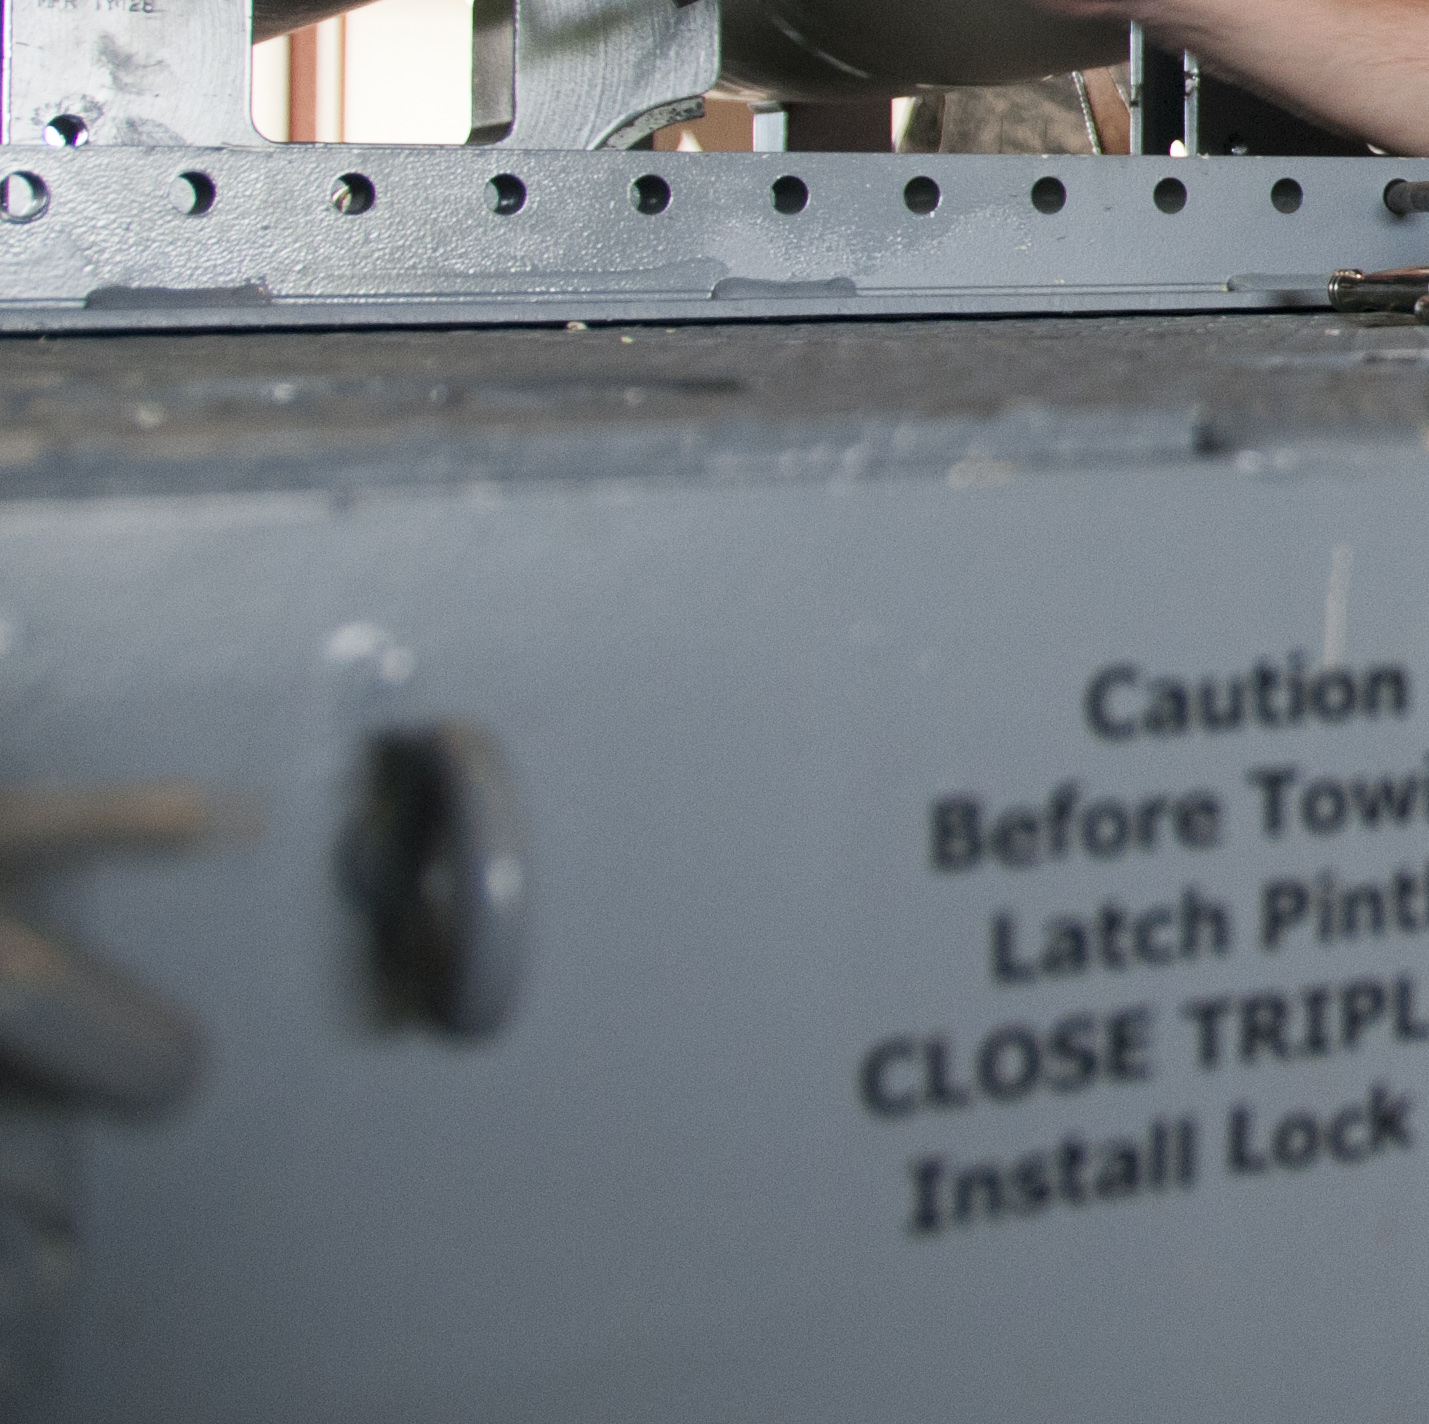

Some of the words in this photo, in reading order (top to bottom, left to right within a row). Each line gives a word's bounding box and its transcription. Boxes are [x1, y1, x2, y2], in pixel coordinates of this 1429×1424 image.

[1082, 650, 1413, 743] Caution
[929, 781, 1222, 874] Before
[991, 889, 1231, 986] Latch
[858, 1007, 1149, 1121] CLOSE
[908, 1118, 1198, 1238] Install
[1226, 1084, 1412, 1176] Lock
